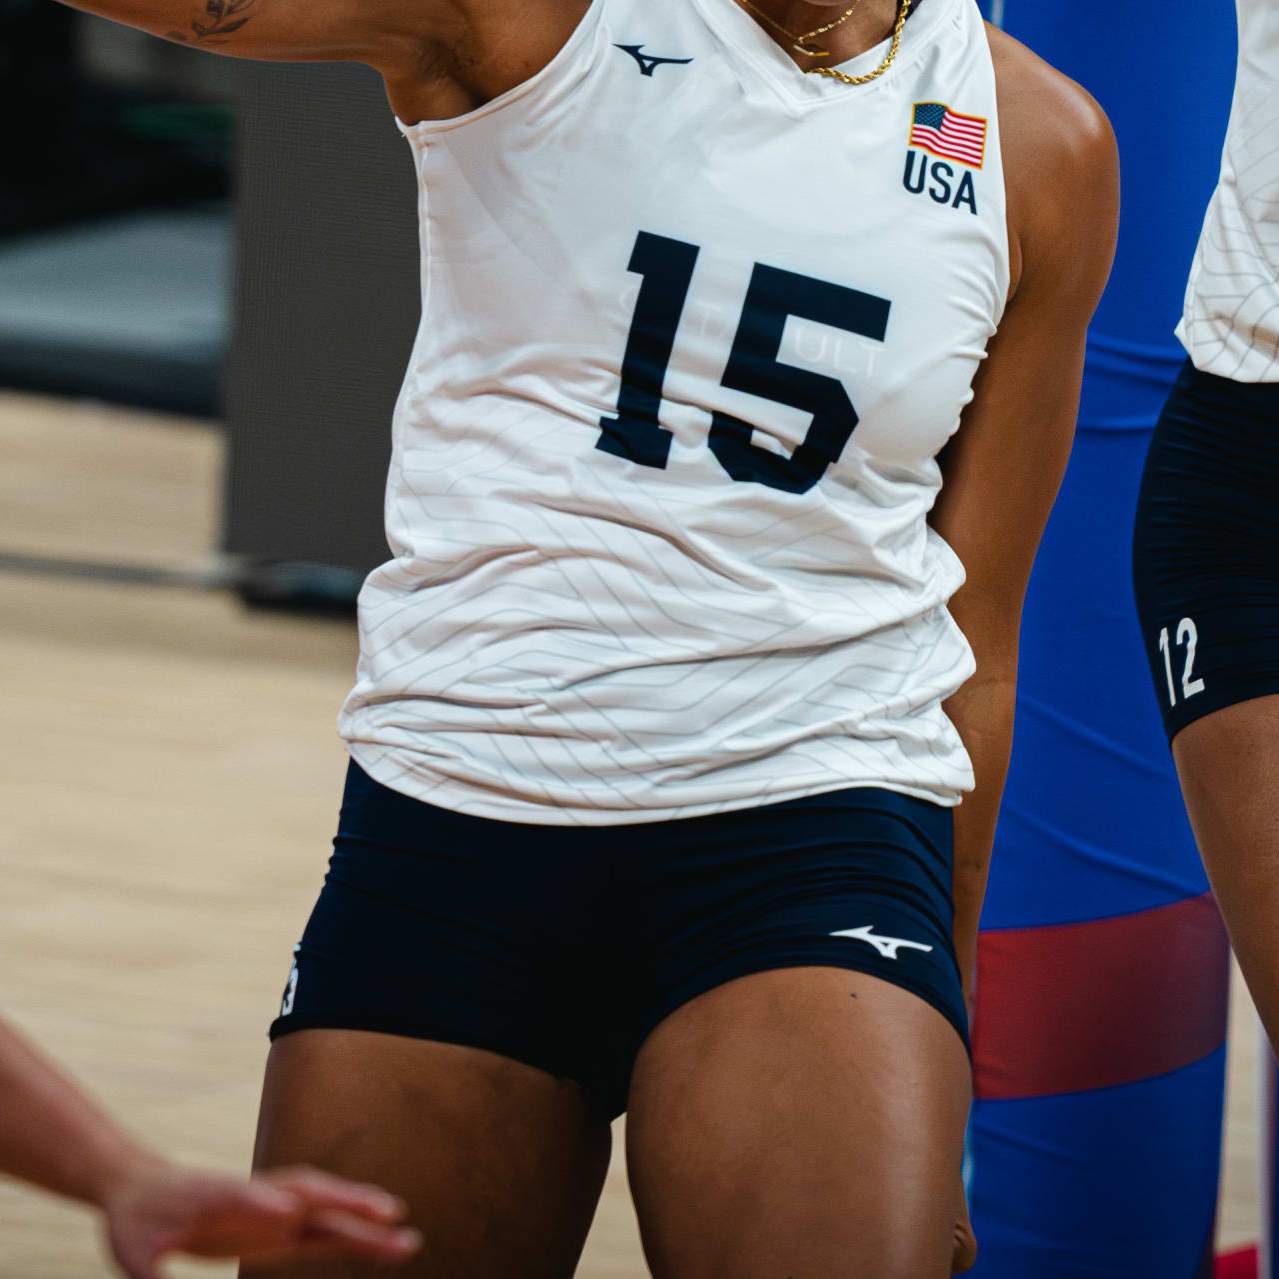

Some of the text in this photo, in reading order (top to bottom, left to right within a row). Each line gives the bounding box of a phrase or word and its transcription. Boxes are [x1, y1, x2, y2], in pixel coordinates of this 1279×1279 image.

[902, 149, 978, 216] USA
[595, 230, 893, 495] 15
[1158, 616, 1206, 708] 12
